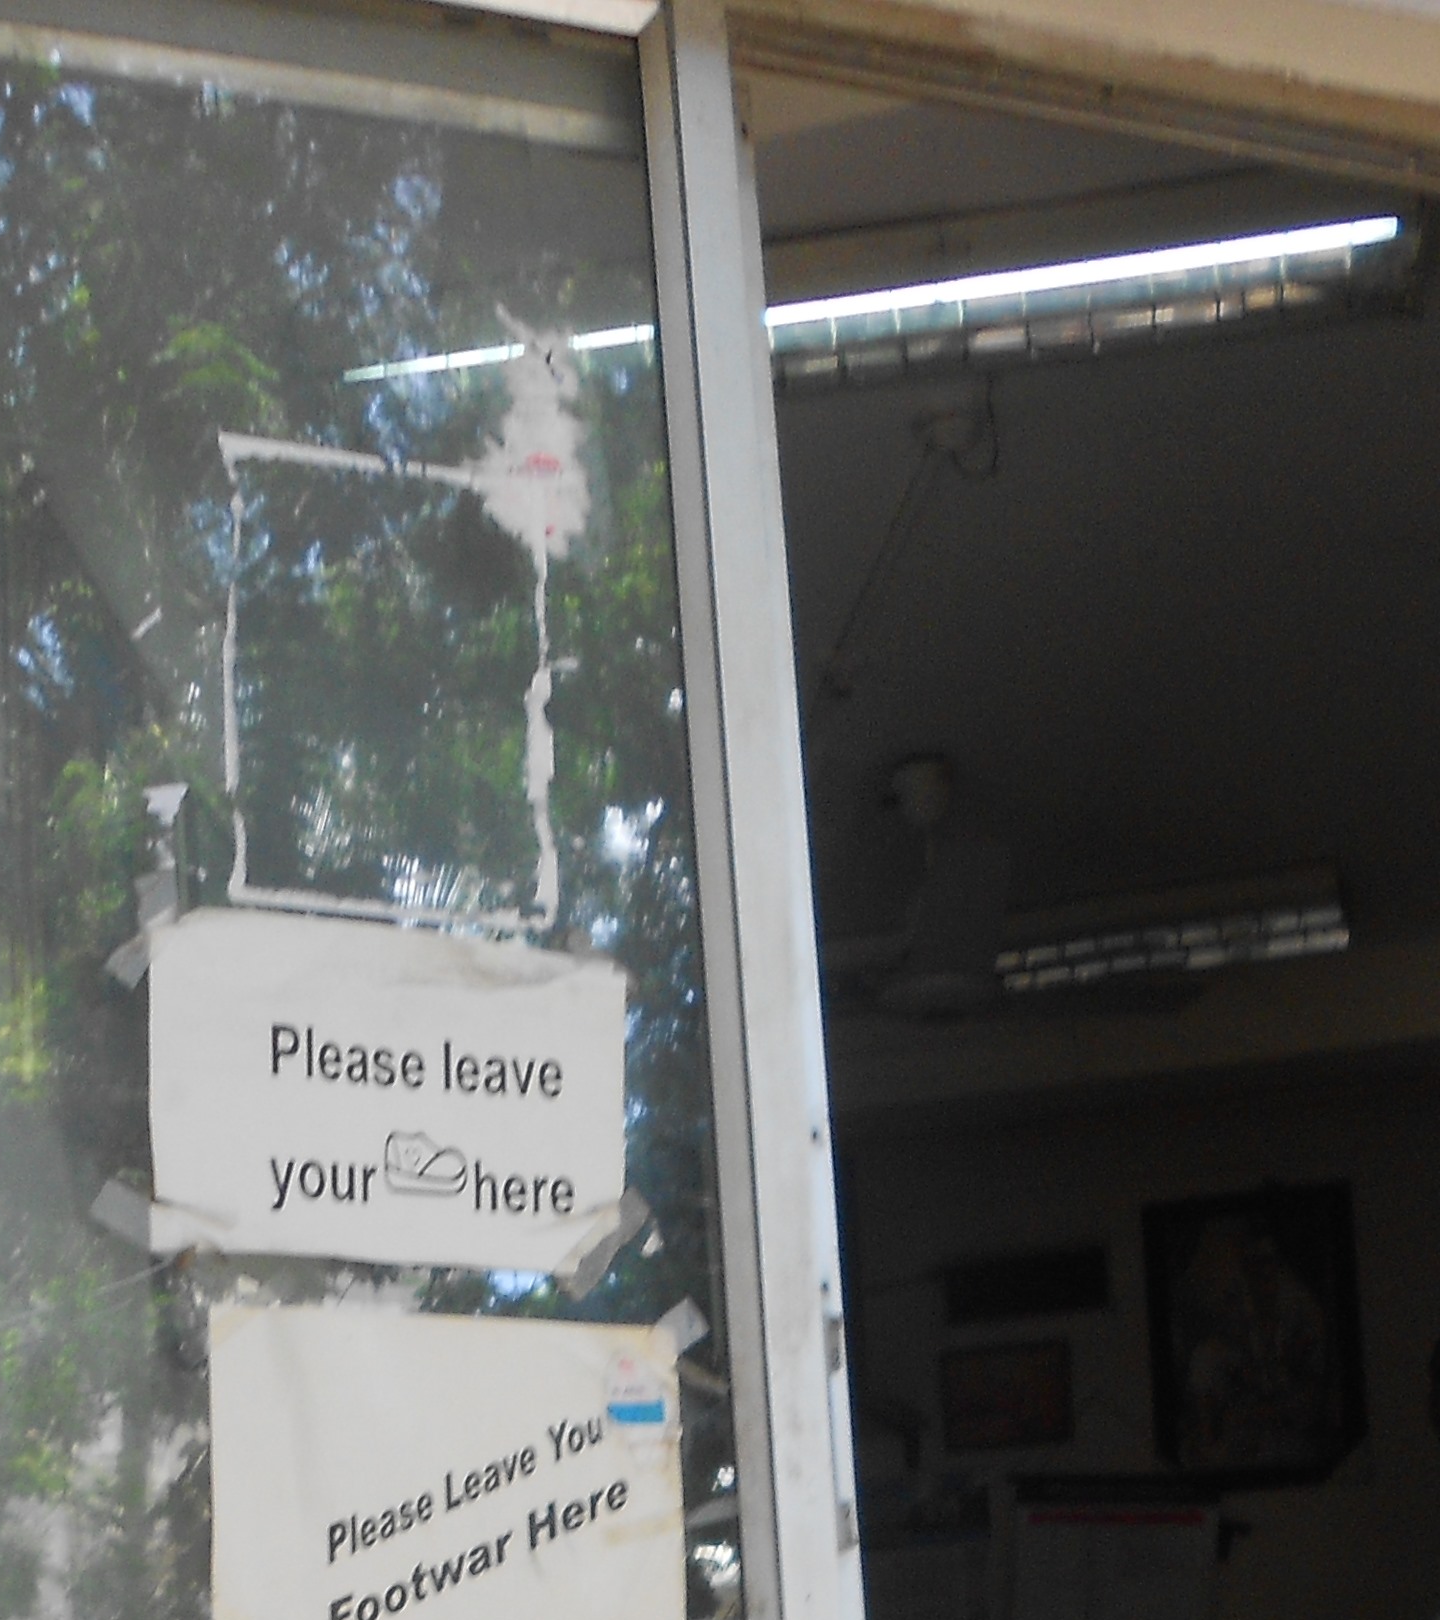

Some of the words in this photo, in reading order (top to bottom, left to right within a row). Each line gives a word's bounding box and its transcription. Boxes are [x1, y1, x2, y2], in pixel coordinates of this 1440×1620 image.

[269, 1023, 425, 1090] Please
[441, 1040, 565, 1100] leave
[269, 1155, 378, 1210] your
[473, 1162, 577, 1215] here
[326, 1496, 433, 1565] Please
[443, 1447, 538, 1512] Leave
[546, 1417, 604, 1464] You
[527, 1477, 631, 1552] Here
